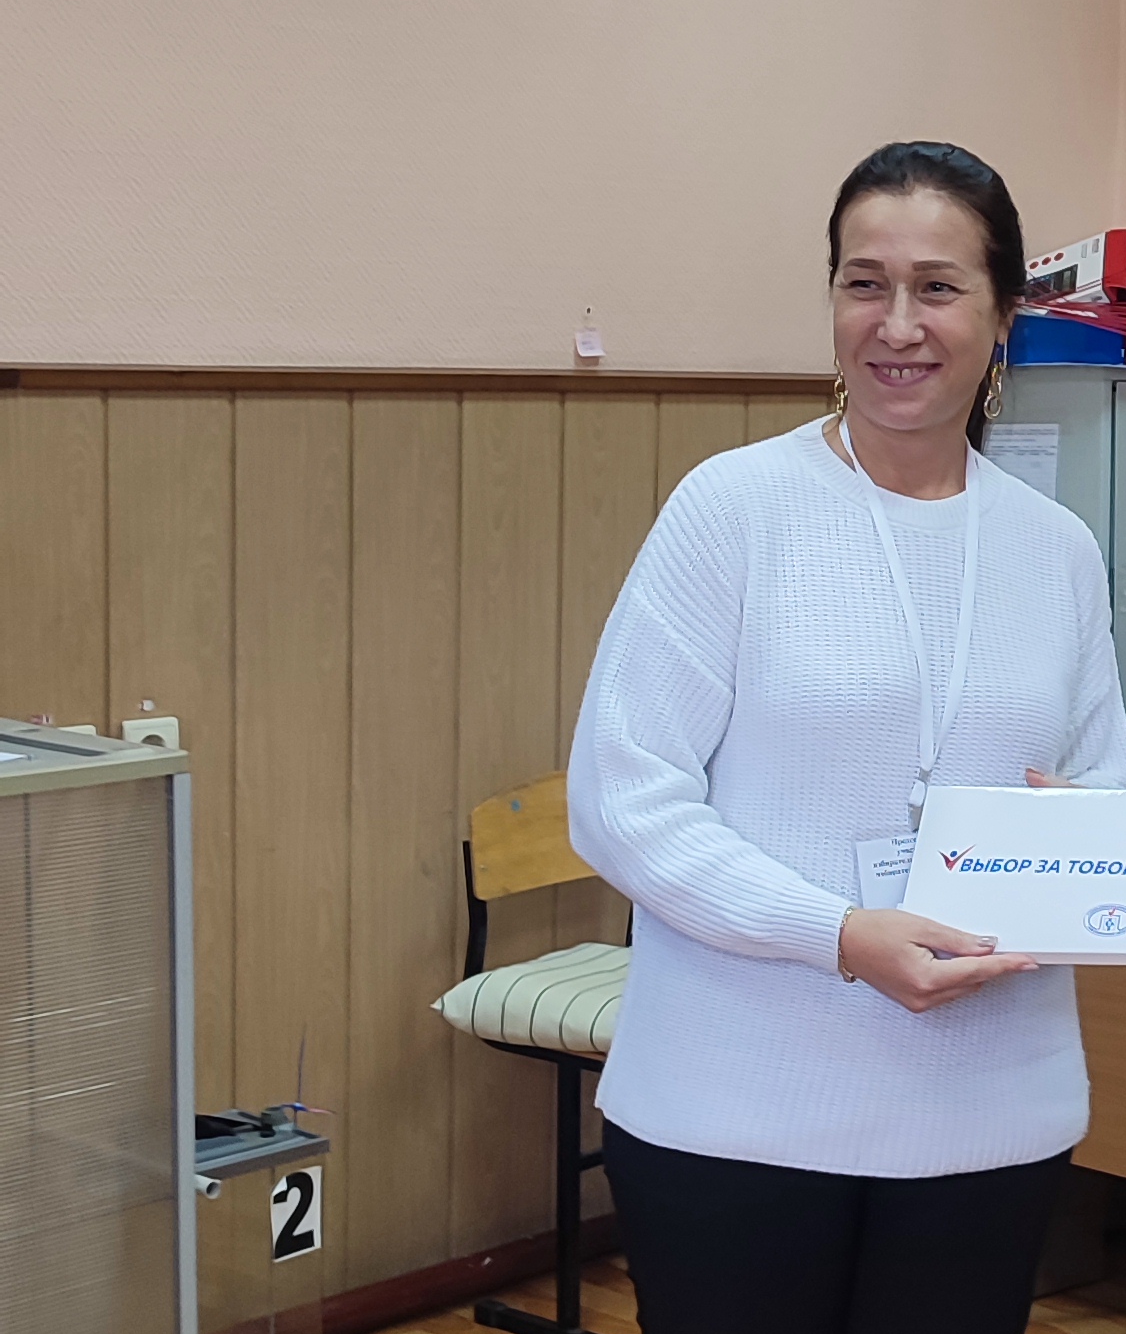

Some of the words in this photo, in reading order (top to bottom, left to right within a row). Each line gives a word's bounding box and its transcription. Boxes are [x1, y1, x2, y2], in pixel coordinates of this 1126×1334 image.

[959, 858, 1032, 873] ВЫБОР
[1034, 859, 1061, 873] ЗА
[273, 1171, 315, 1259] 2
